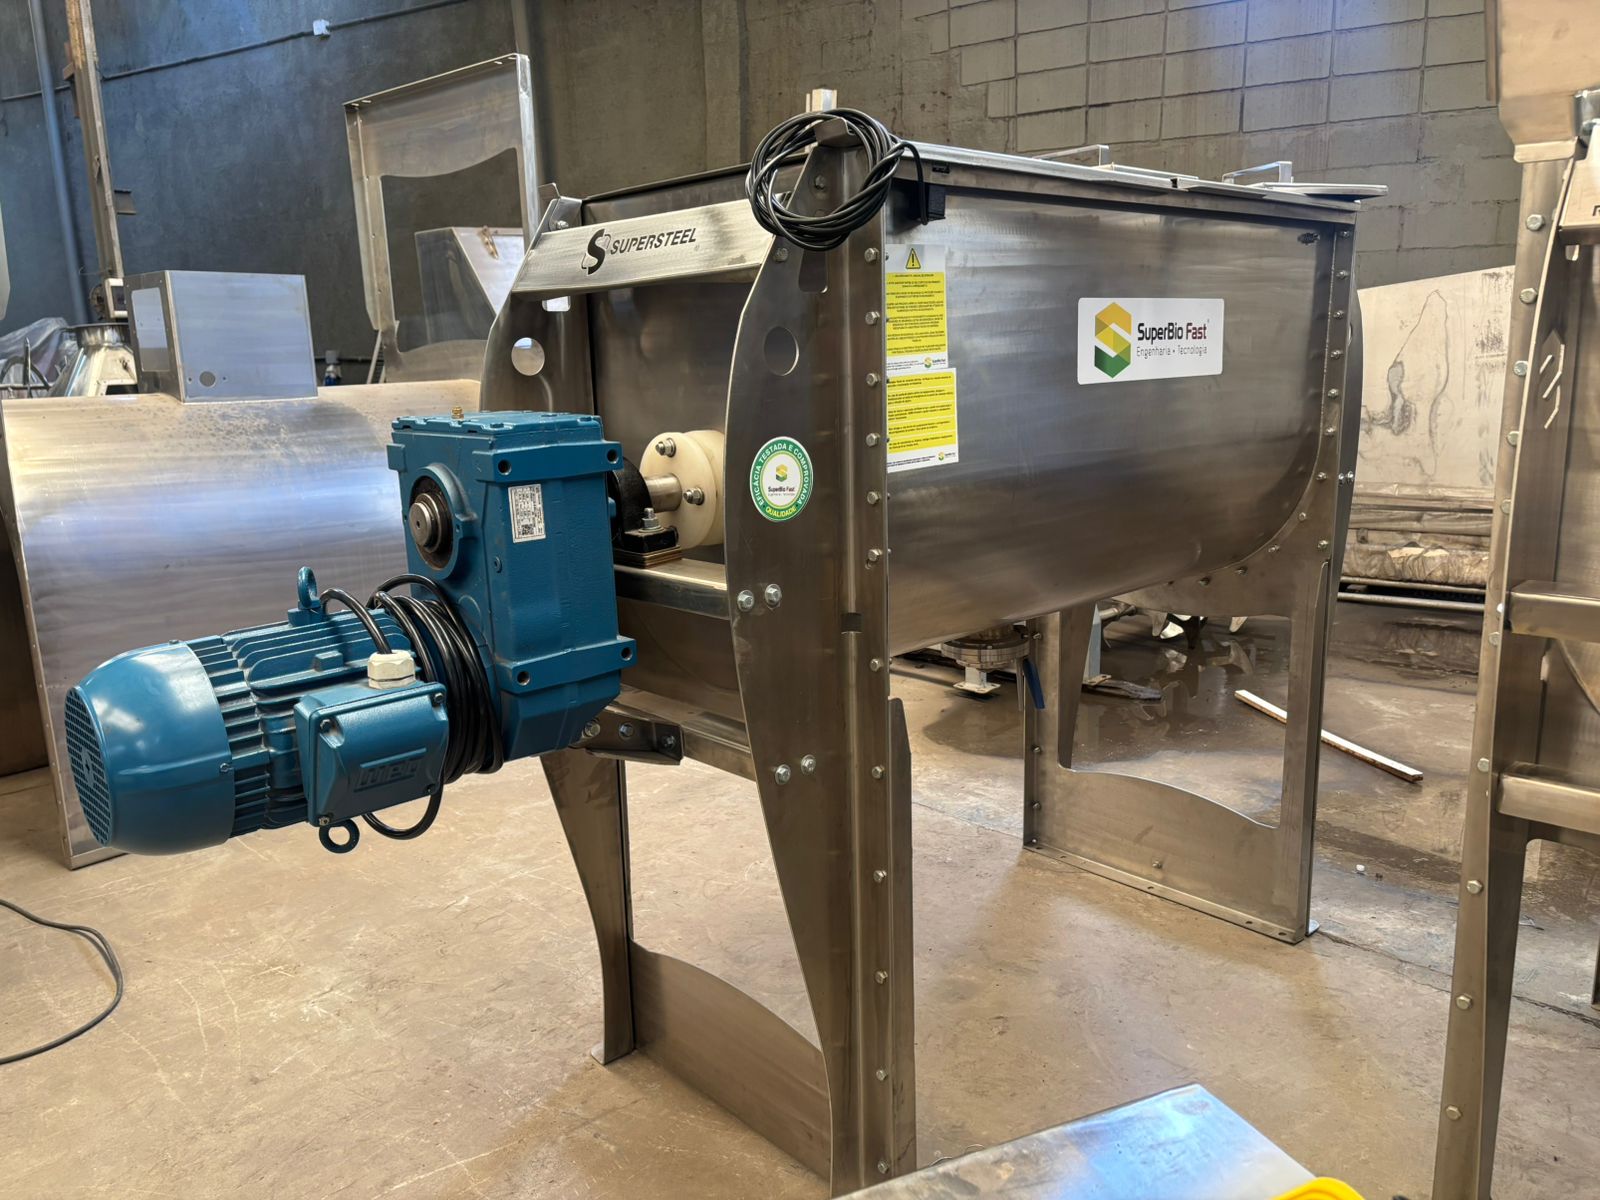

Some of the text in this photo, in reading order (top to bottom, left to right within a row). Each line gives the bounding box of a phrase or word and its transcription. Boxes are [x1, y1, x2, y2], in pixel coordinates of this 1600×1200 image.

[610, 228, 697, 255] SUPERSTEEL
[1137, 322, 1207, 345] SuperBio Fast
[1137, 345, 1207, 359] Engenharia Tecnologia
[759, 443, 787, 463] TESTADA
[793, 448, 809, 505] COMPROVADA
[765, 506, 797, 517] QUALIDADE
